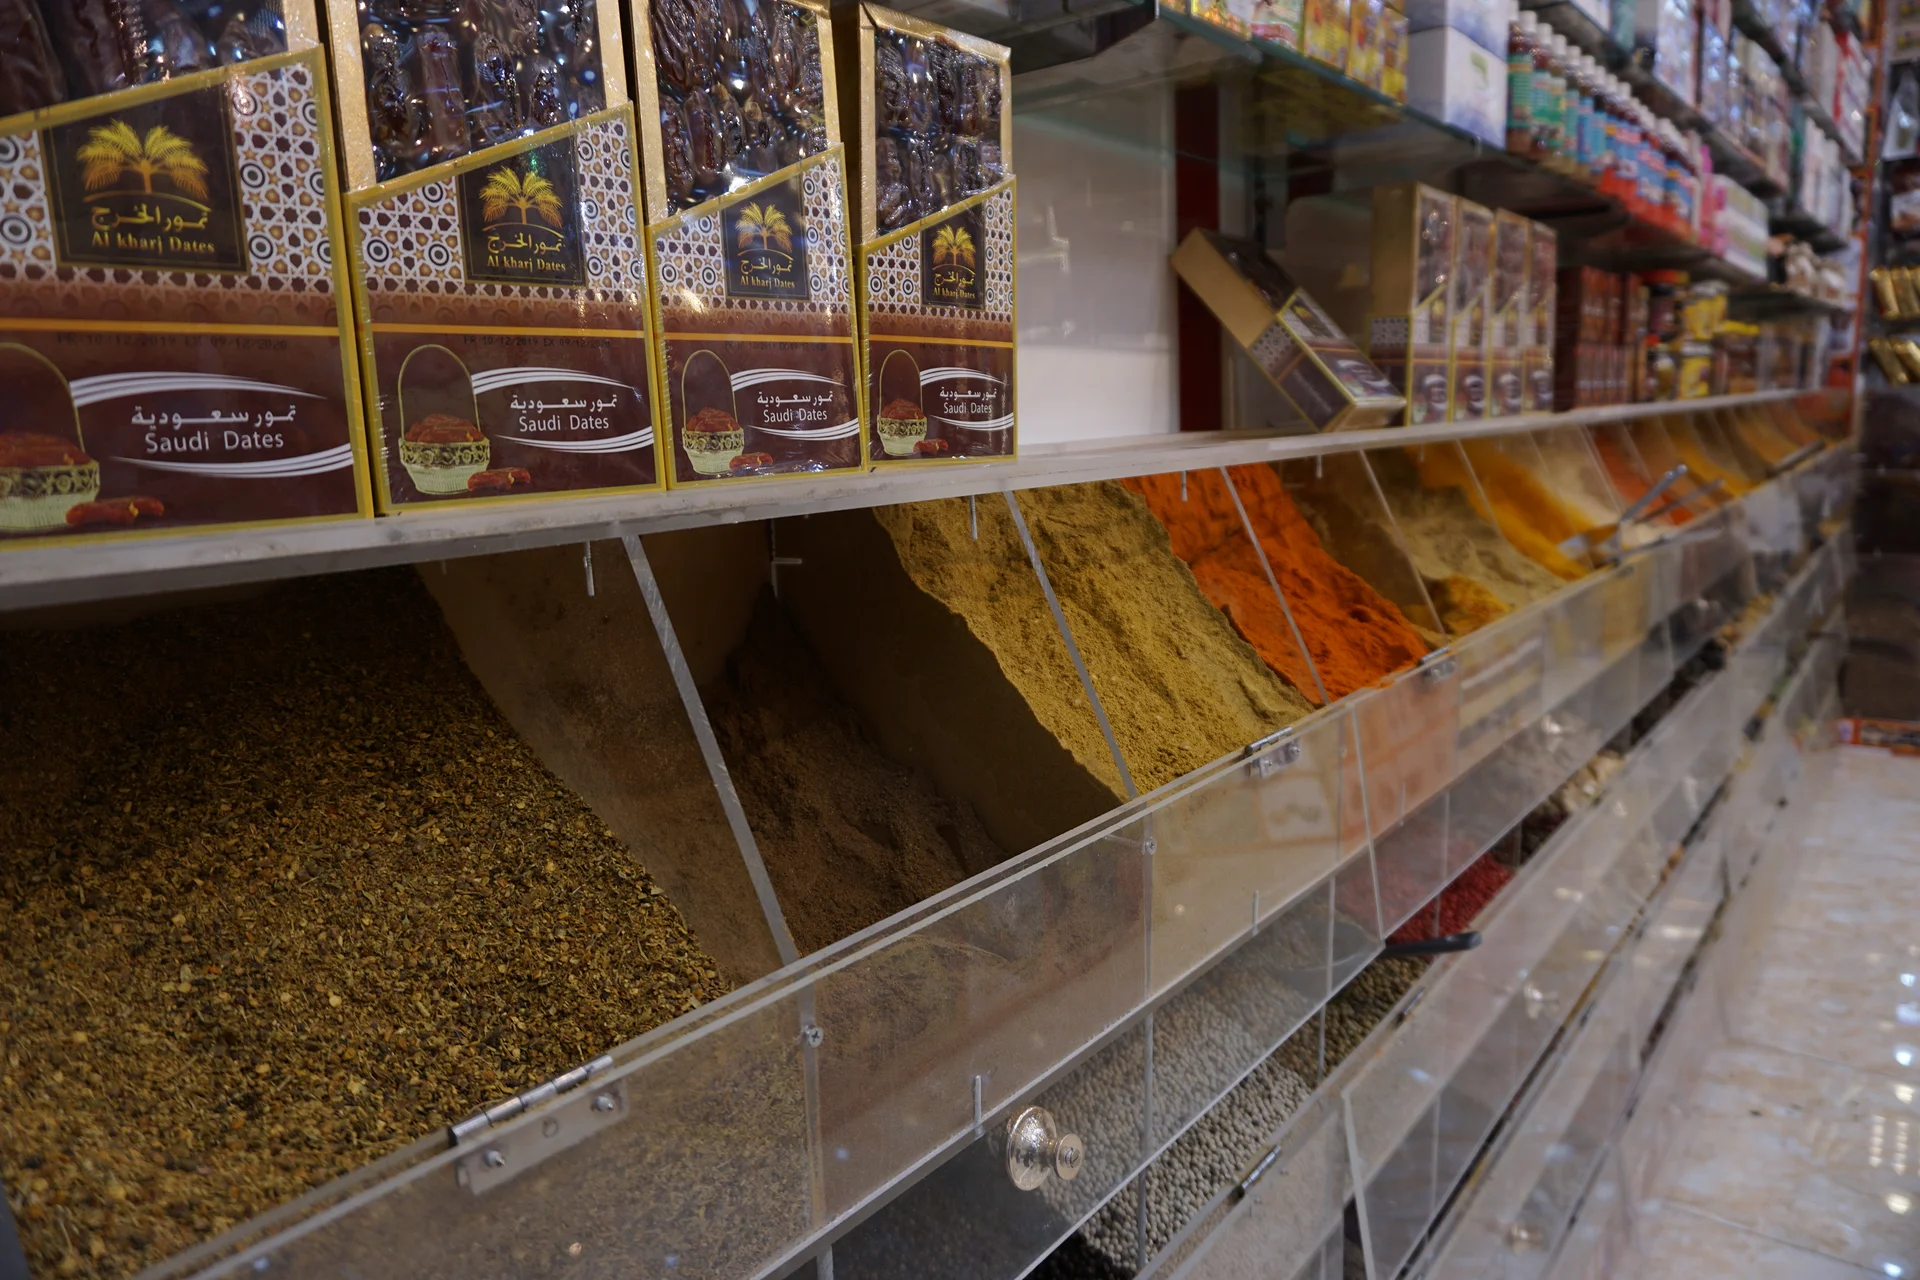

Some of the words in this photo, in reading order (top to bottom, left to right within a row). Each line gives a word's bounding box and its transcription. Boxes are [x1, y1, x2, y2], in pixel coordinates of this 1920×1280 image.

[91, 203, 161, 231] الخرج
[163, 211, 208, 233] تمور
[92, 231, 110, 248] Al
[169, 236, 216, 253] Dates
[487, 232, 532, 254] الخرج
[533, 238, 562, 255] تمور
[487, 255, 500, 268] Al
[536, 258, 567, 272] Dates
[740, 256, 771, 275] الخرج
[772, 260, 792, 276] تمور
[740, 275, 749, 286] Al
[774, 277, 796, 288] Dates
[757, 391, 811, 408] سعودية
[813, 390, 834, 406] تمور
[939, 386, 981, 401] سعودية
[981, 388, 997, 401] تمور
[510, 394, 587, 414] سعودية
[589, 394, 618, 412] تمور
[943, 402, 967, 414] Saudi
[970, 402, 992, 414] Dates
[131, 405, 249, 431] سعودية
[254, 404, 296, 427] تمور
[519, 414, 561, 432] Saudi
[569, 414, 609, 430] Dates
[763, 408, 793, 423] Saudi
[798, 408, 828, 421] Dates
[144, 430, 209, 453] Saudi
[223, 430, 284, 450] Dates
